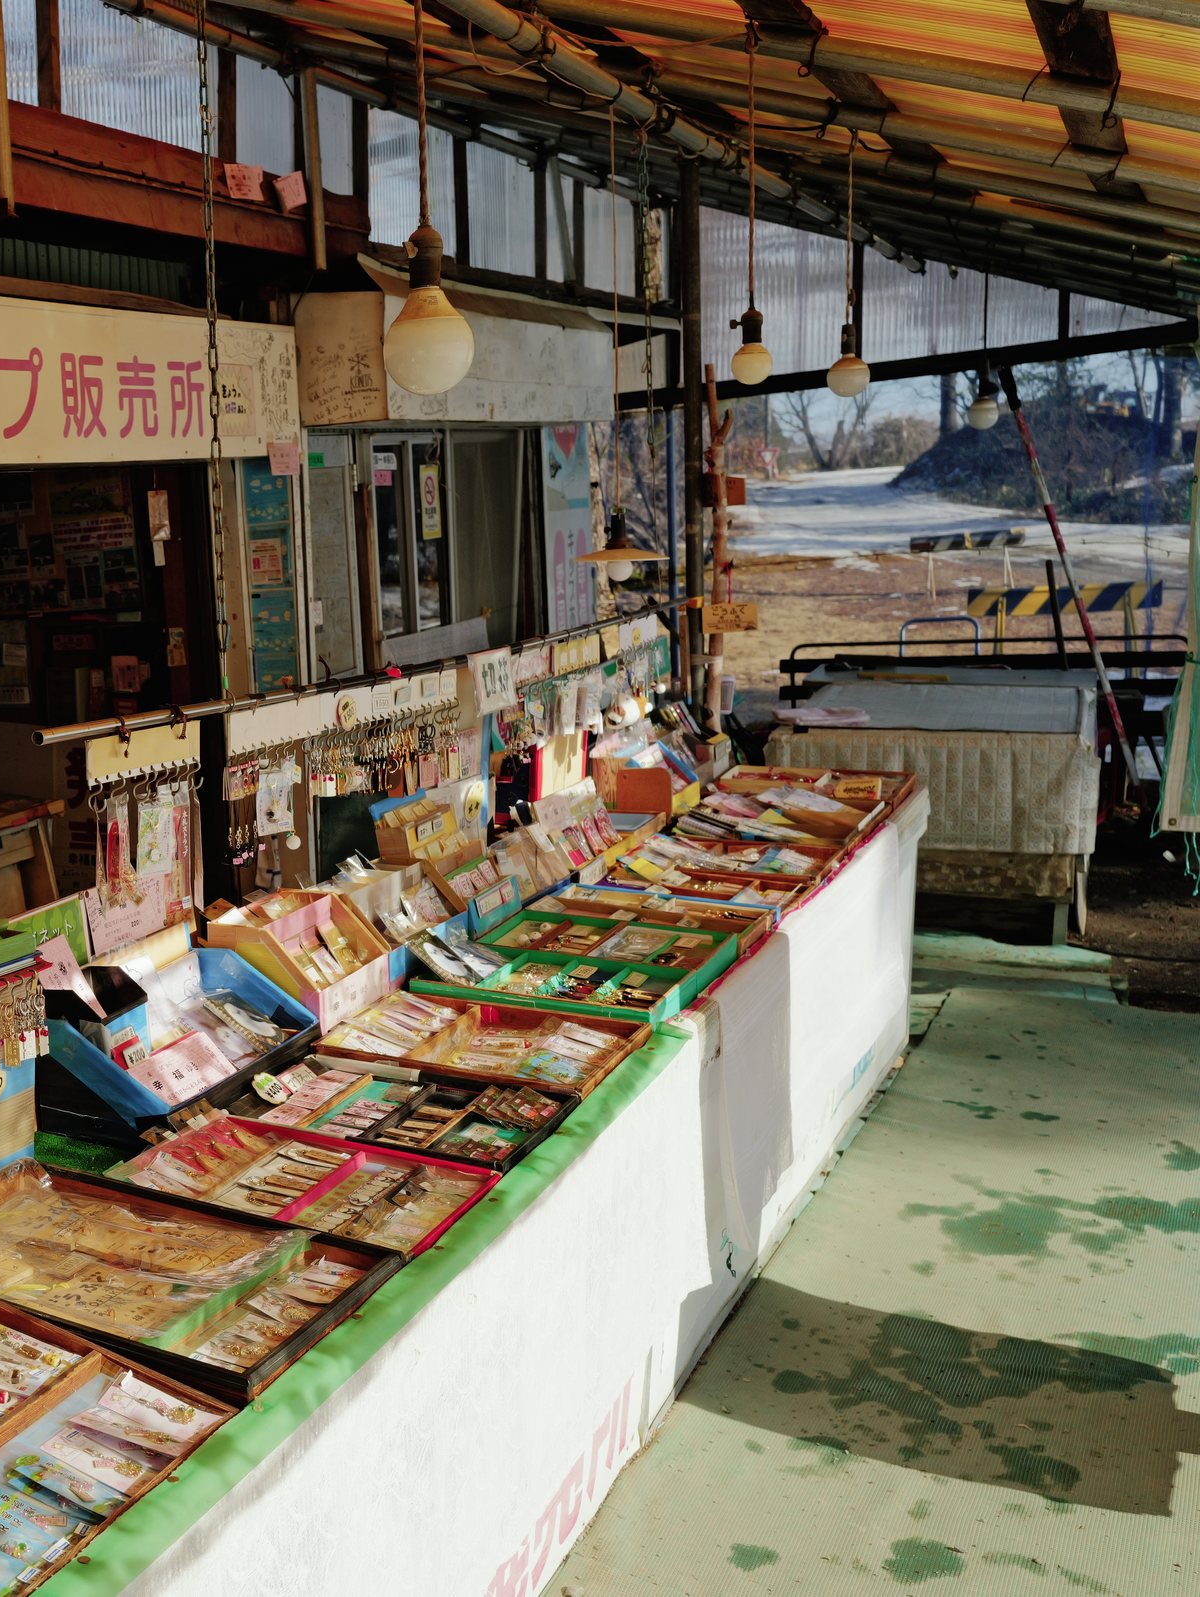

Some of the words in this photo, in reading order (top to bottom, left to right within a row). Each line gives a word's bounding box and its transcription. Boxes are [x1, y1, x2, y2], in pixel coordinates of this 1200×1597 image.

[481, 656, 511, 699] 切符
[127, 1047, 146, 1065] ¥200
[265, 1082, 283, 1099] ¥400
